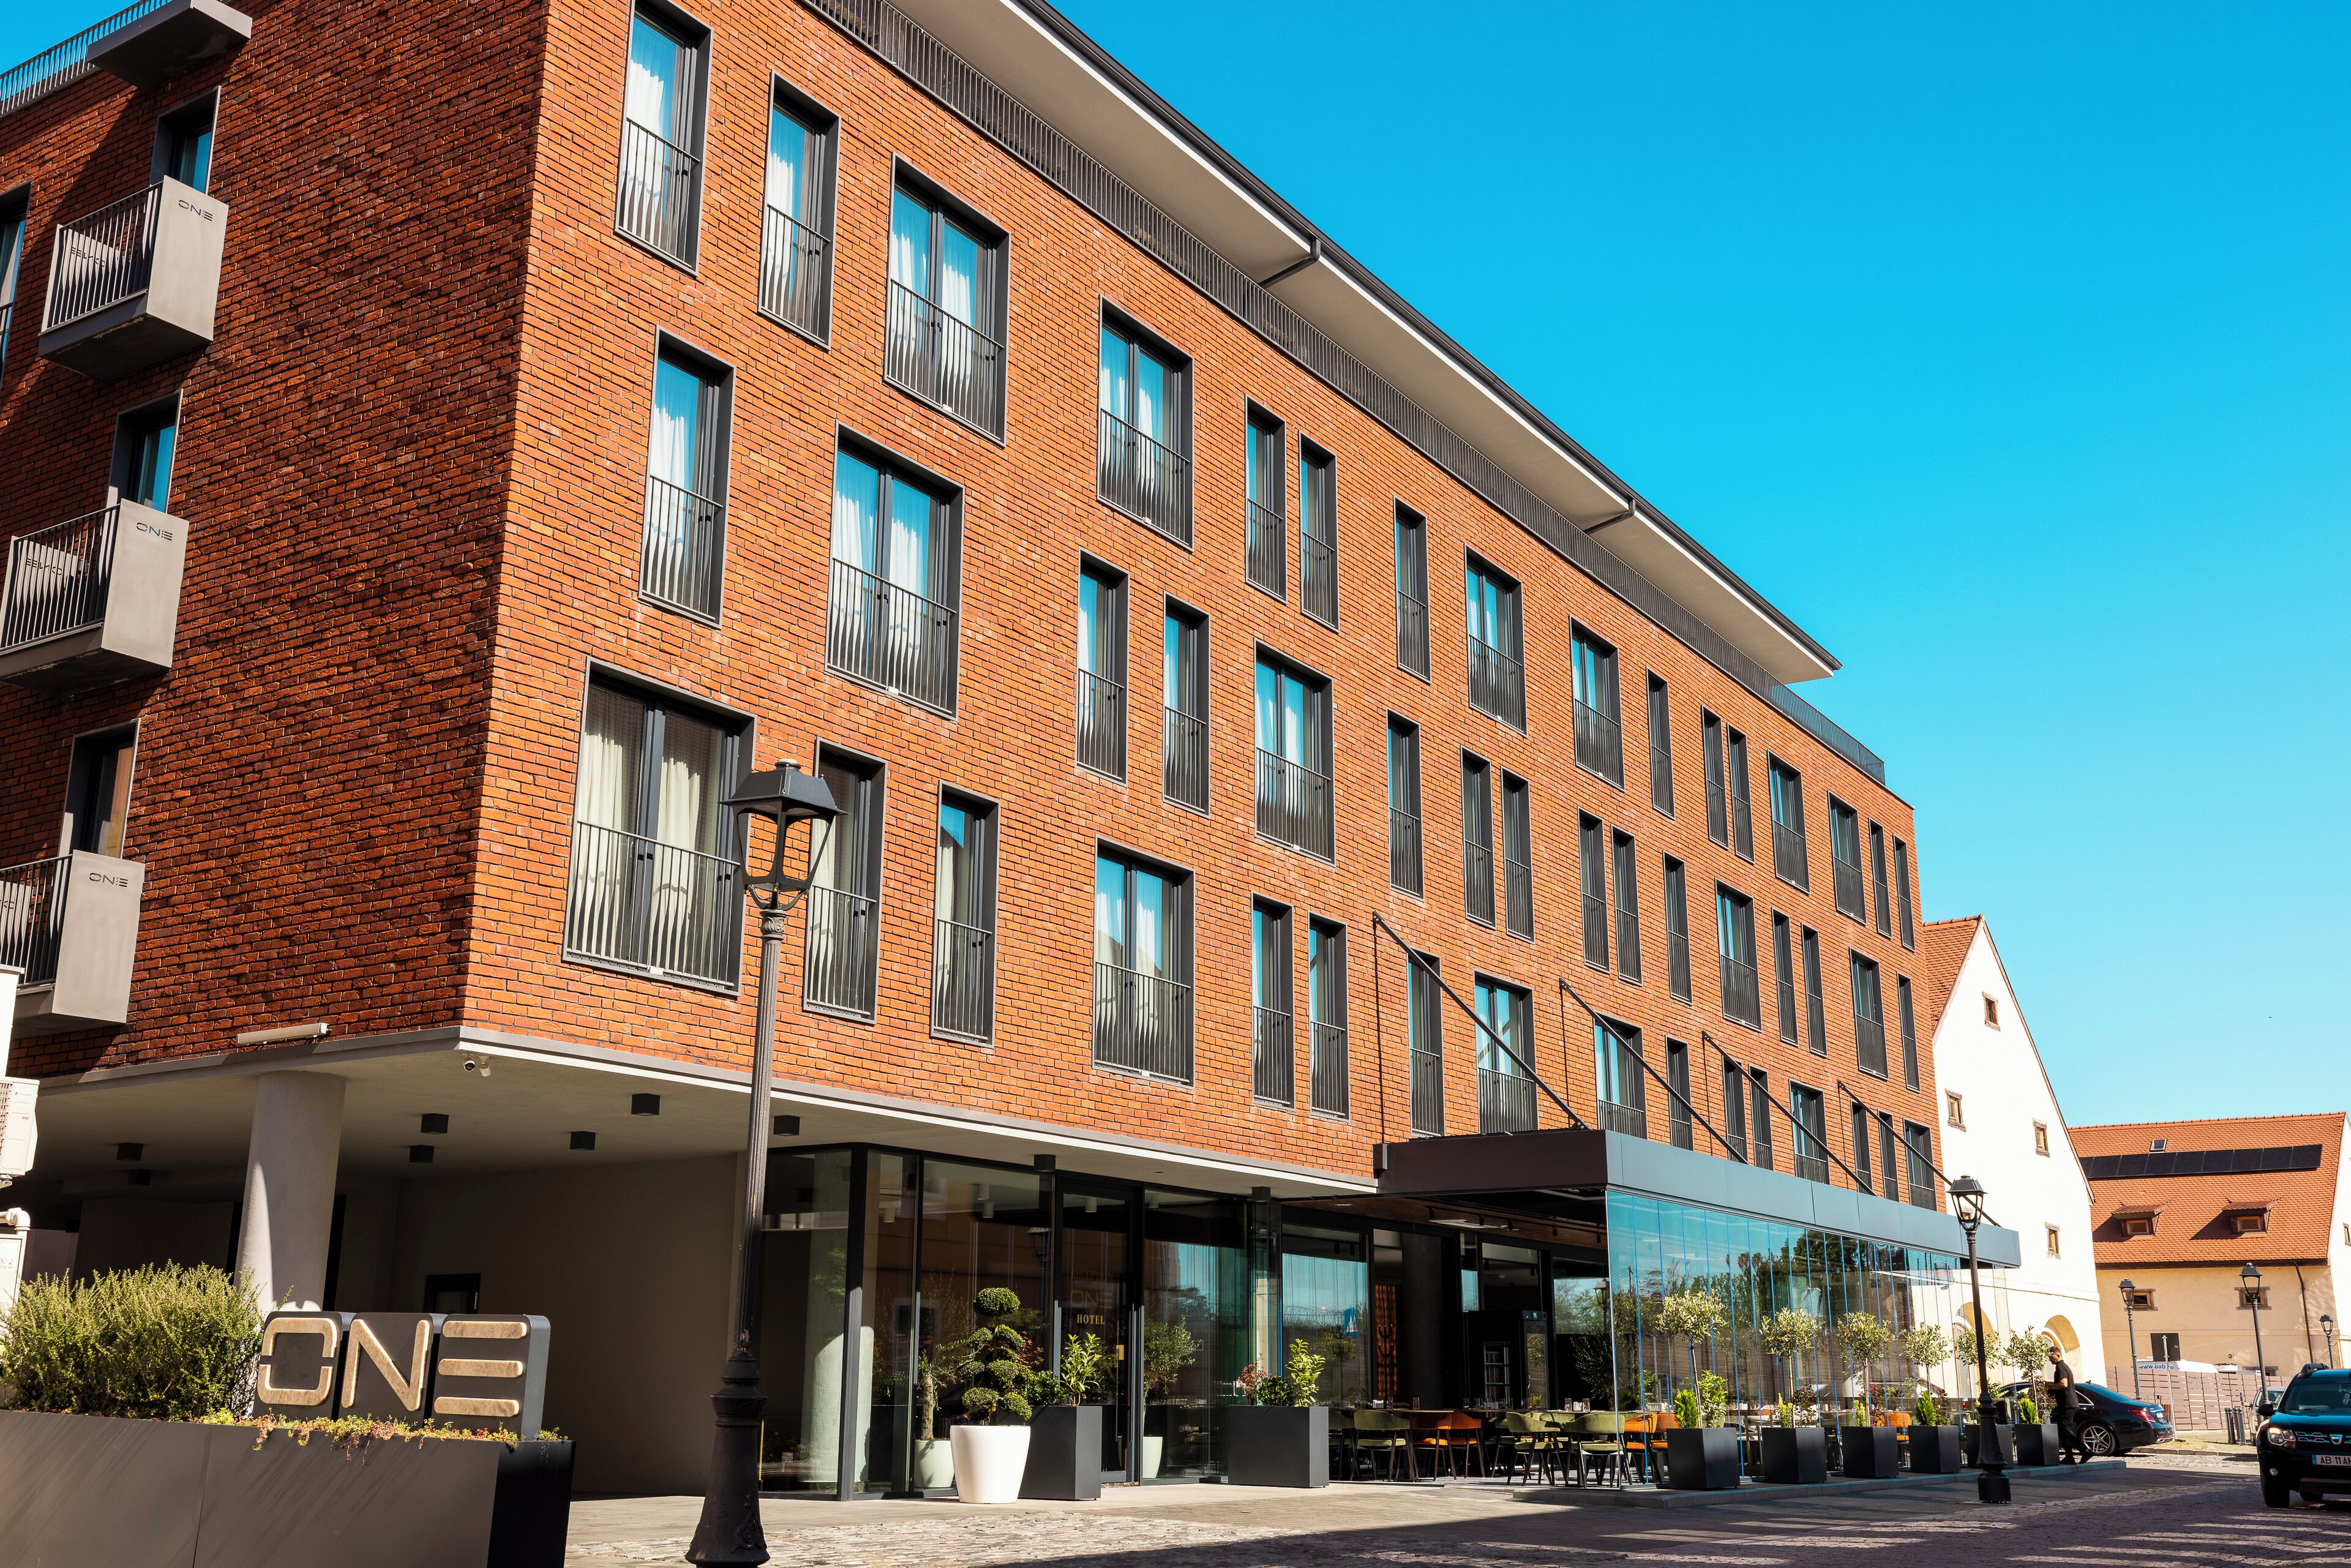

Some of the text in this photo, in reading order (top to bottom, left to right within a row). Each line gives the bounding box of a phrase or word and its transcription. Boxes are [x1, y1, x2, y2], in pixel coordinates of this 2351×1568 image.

[178, 200, 213, 221] ONE
[137, 522, 173, 541] ONE
[89, 872, 128, 887] ONE
[1071, 1289, 1112, 1309] ONE
[1077, 1314, 1105, 1325] HOTEL
[257, 1317, 527, 1417] ONE
[2320, 1456, 2332, 1465] AB
